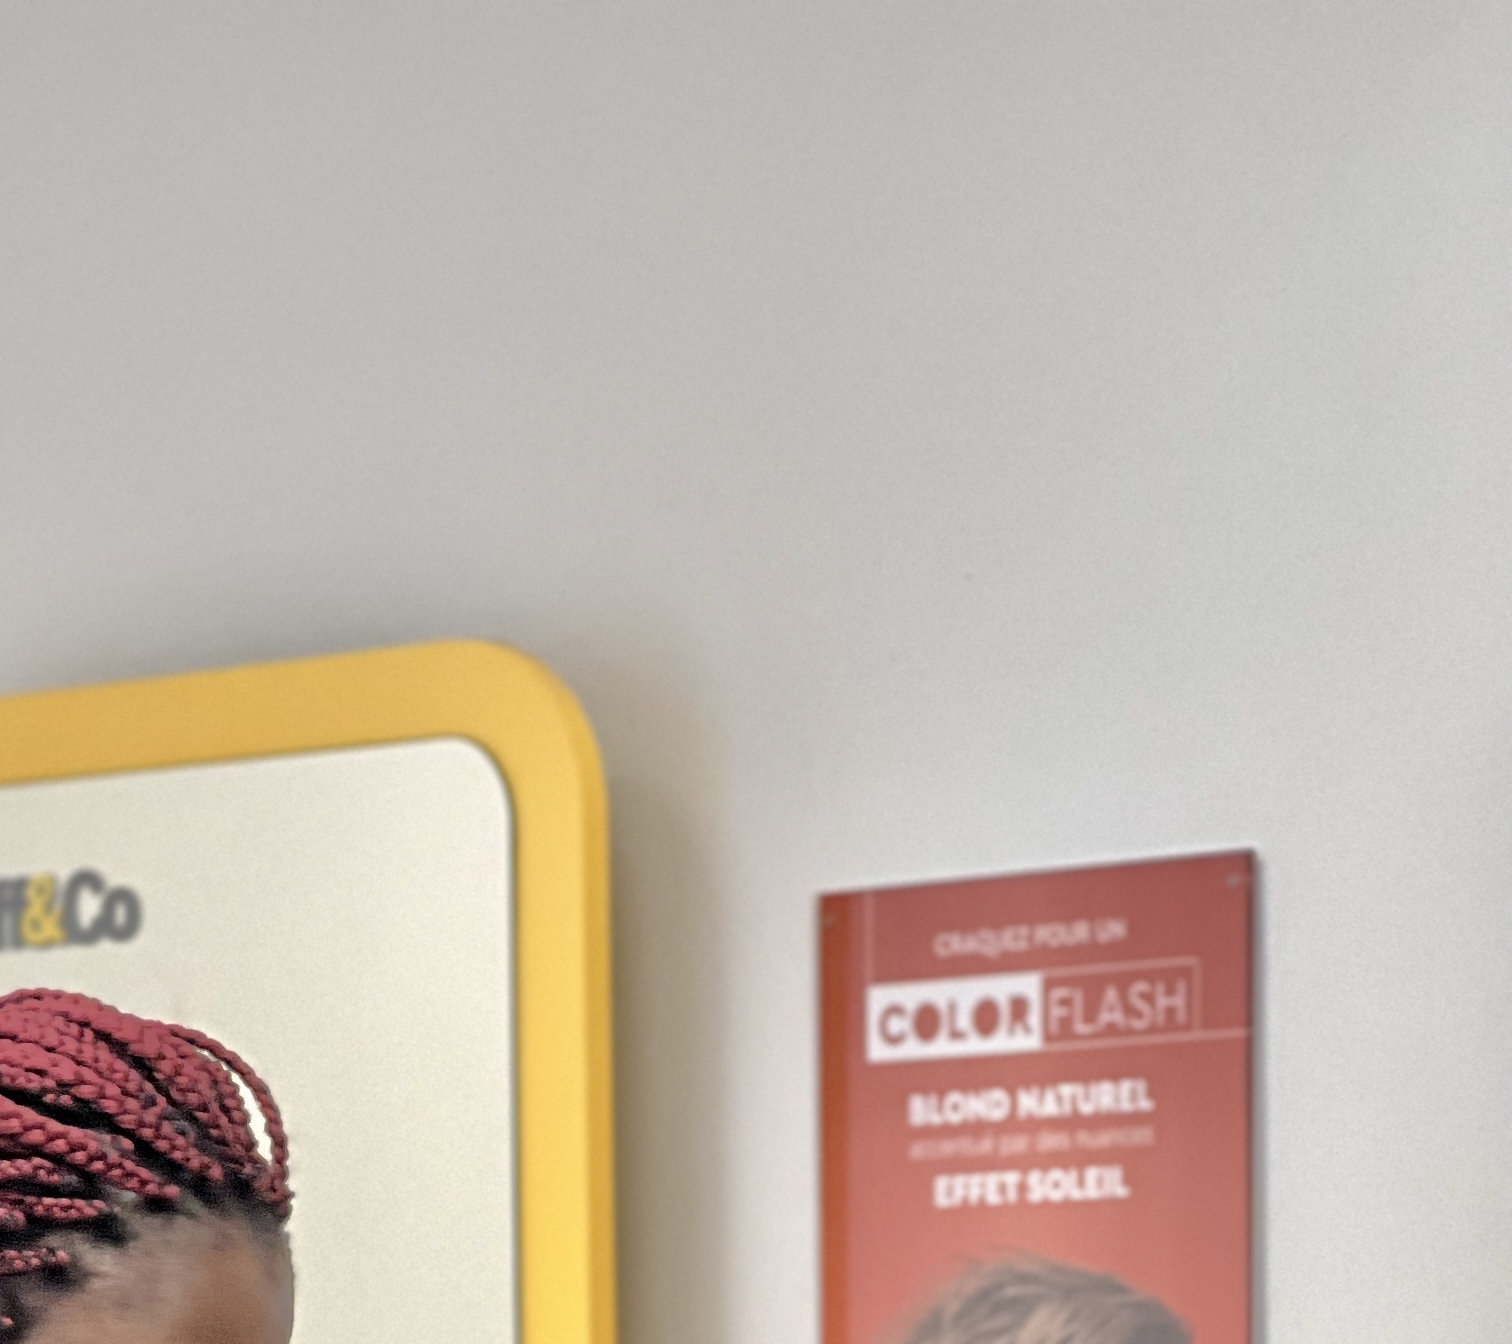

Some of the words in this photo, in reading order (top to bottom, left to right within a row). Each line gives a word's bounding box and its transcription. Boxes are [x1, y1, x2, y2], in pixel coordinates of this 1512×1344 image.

[1033, 919, 1090, 949] POUR
[880, 997, 1033, 1045] COLOR
[1048, 981, 1187, 1034] FLASH
[907, 1089, 1012, 1127] BLOND
[1017, 1078, 1156, 1120] NATUREL
[933, 1170, 1023, 1209] EFFET
[1026, 1164, 1131, 1202] SOLEIL
